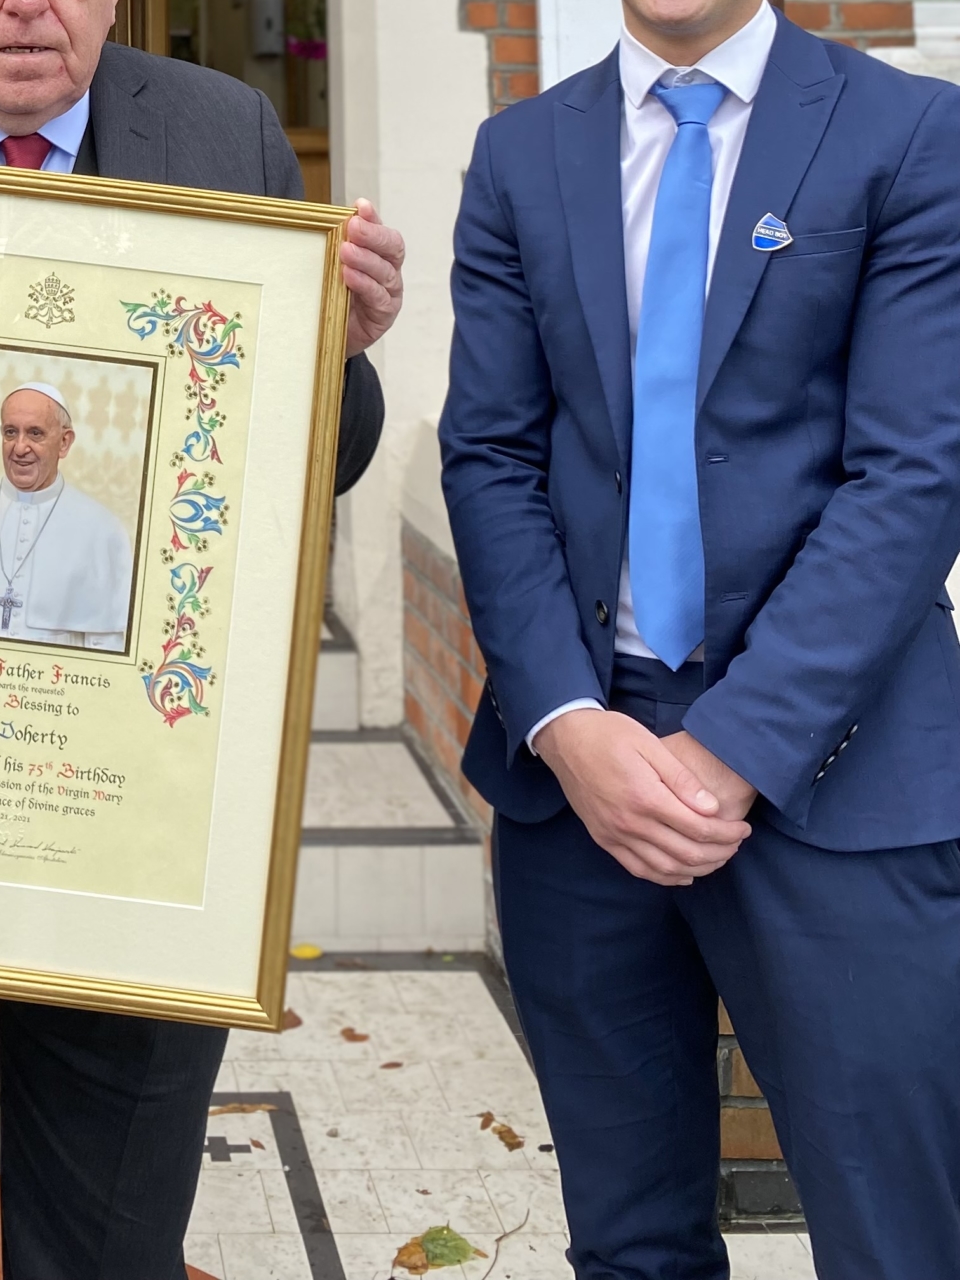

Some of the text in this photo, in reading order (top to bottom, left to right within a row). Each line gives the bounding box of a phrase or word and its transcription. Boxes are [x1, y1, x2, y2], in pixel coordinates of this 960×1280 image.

[51, 664, 111, 688] Francis
[18, 683, 29, 693] the
[31, 687, 65, 696] requested
[3, 693, 63, 717] Blessing
[66, 702, 80, 716] to
[3, 755, 24, 773] his
[56, 762, 126, 788] Birthday
[25, 781, 36, 794] of
[38, 782, 54, 796] the
[57, 785, 90, 800] Virgin
[92, 789, 123, 805] Mary
[13, 814, 31, 823] 2021
[15, 796, 27, 810] of
[28, 797, 60, 812] divine
[61, 804, 96, 817] graces
